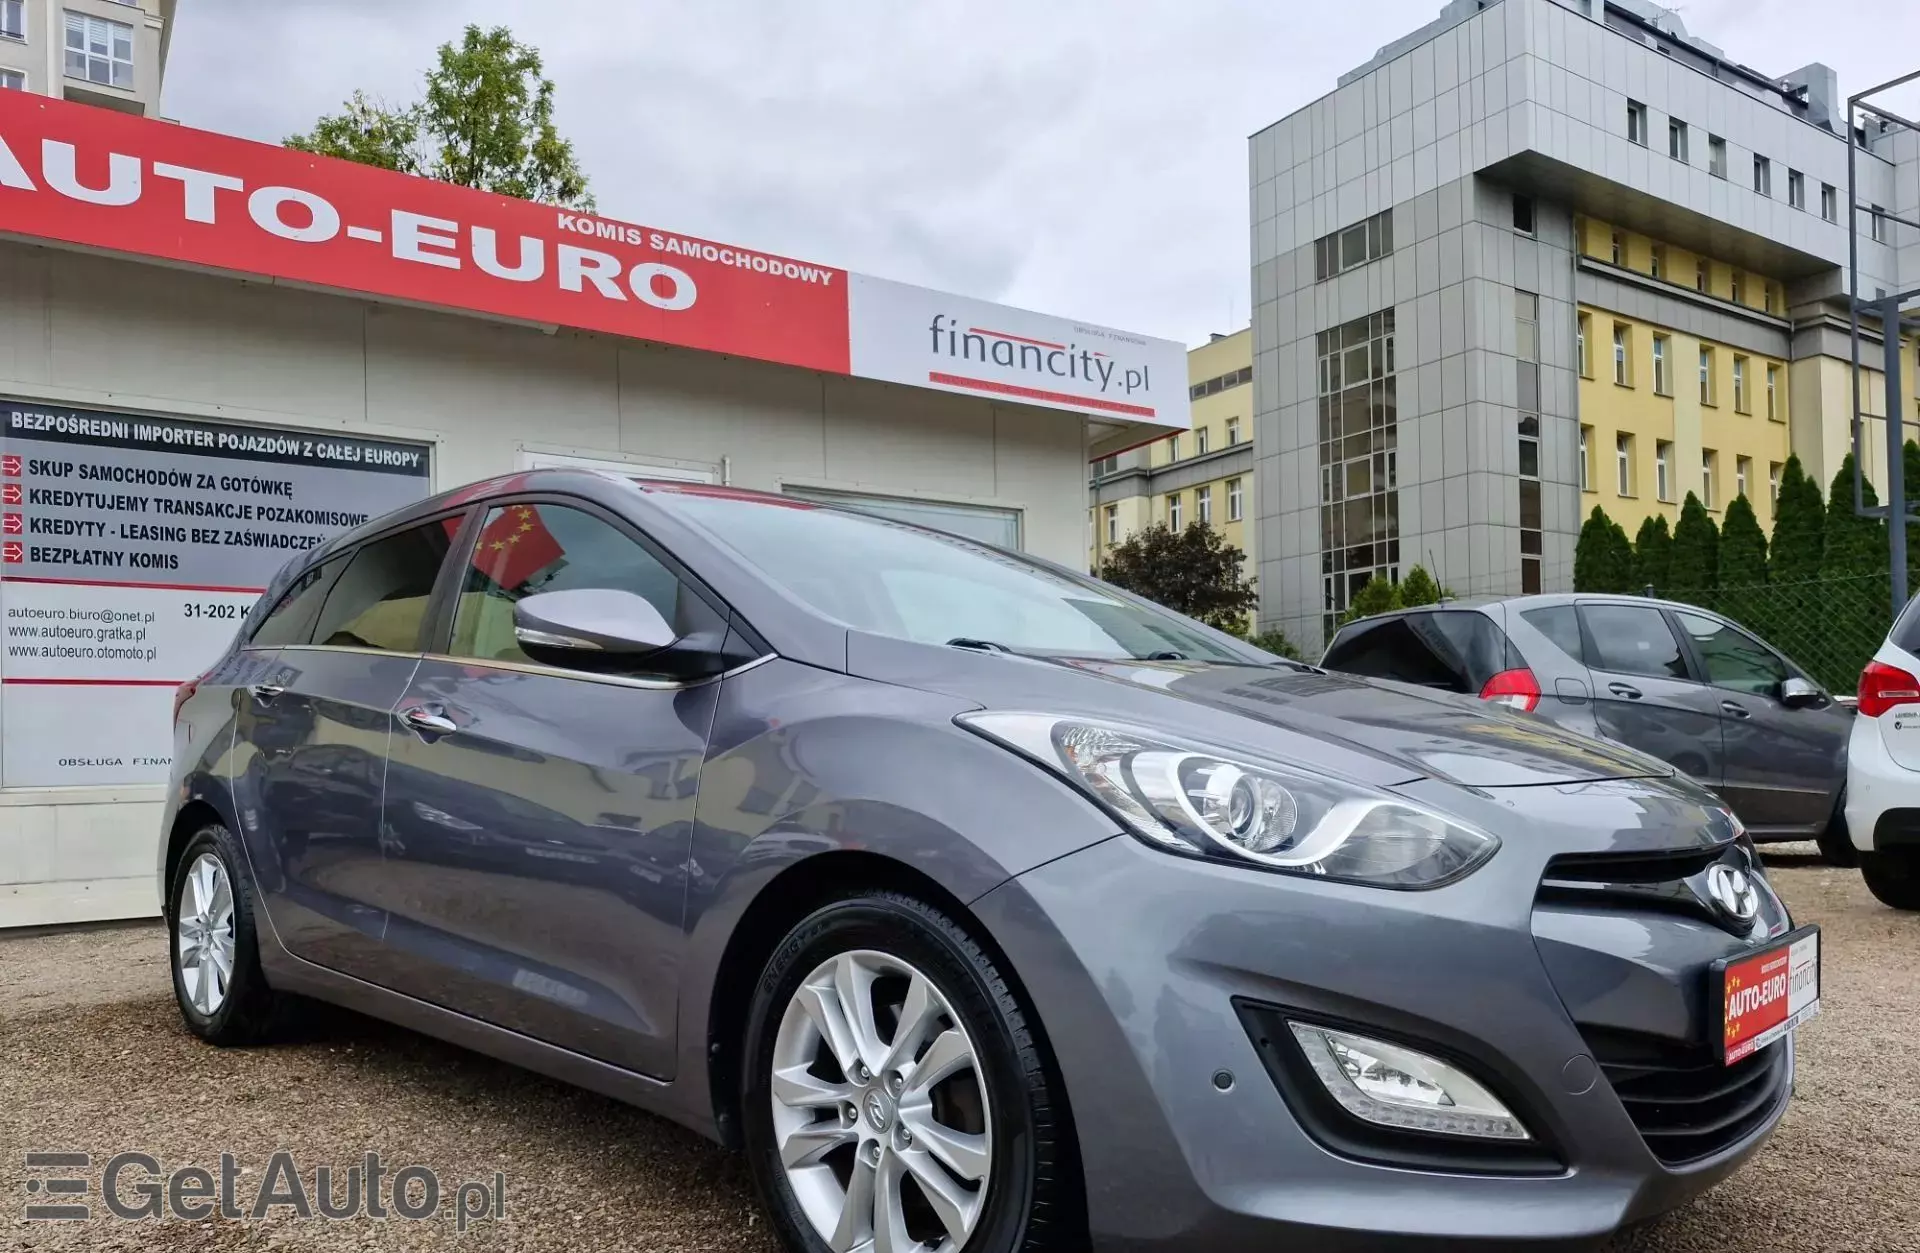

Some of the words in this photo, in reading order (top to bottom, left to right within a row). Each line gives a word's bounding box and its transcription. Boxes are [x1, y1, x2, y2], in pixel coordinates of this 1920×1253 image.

[557, 213, 642, 246] KOMIS
[650, 234, 833, 286] SAMOCHODOWY
[929, 314, 1149, 394] financity.pl
[11, 411, 129, 439] BEZPOŚREDNI
[133, 423, 215, 448] IMPORTER
[218, 432, 300, 456] POJAZDÓW
[303, 442, 314, 457] Z
[316, 442, 361, 463] CAŁEJ
[364, 447, 420, 468] EUROPY
[28, 459, 74, 478] SKUP
[78, 464, 193, 489] SAMOCHODÓW
[196, 473, 217, 490] ZA
[220, 475, 293, 500] GOTÓWKĘ
[29, 488, 150, 513] KREDYTUJEMY
[153, 497, 252, 520] TRANSAKCJE
[29, 517, 106, 538] KREDYTY
[120, 523, 187, 543] LEASING
[191, 528, 220, 545] BEZ
[29, 546, 125, 567] BEZPŁATNY
[129, 552, 179, 570] KOMIS
[8, 606, 156, 623] autoeuro.biuro@onet.pl
[184, 603, 235, 619] 31-202
[8, 625, 146, 641] www.autoeuro.gratka.pl
[8, 644, 157, 660] www.autoeuro.otomoto.pl
[58, 757, 123, 767] OBSŁUGA
[1728, 973, 1787, 1021] AUTO-EURO
